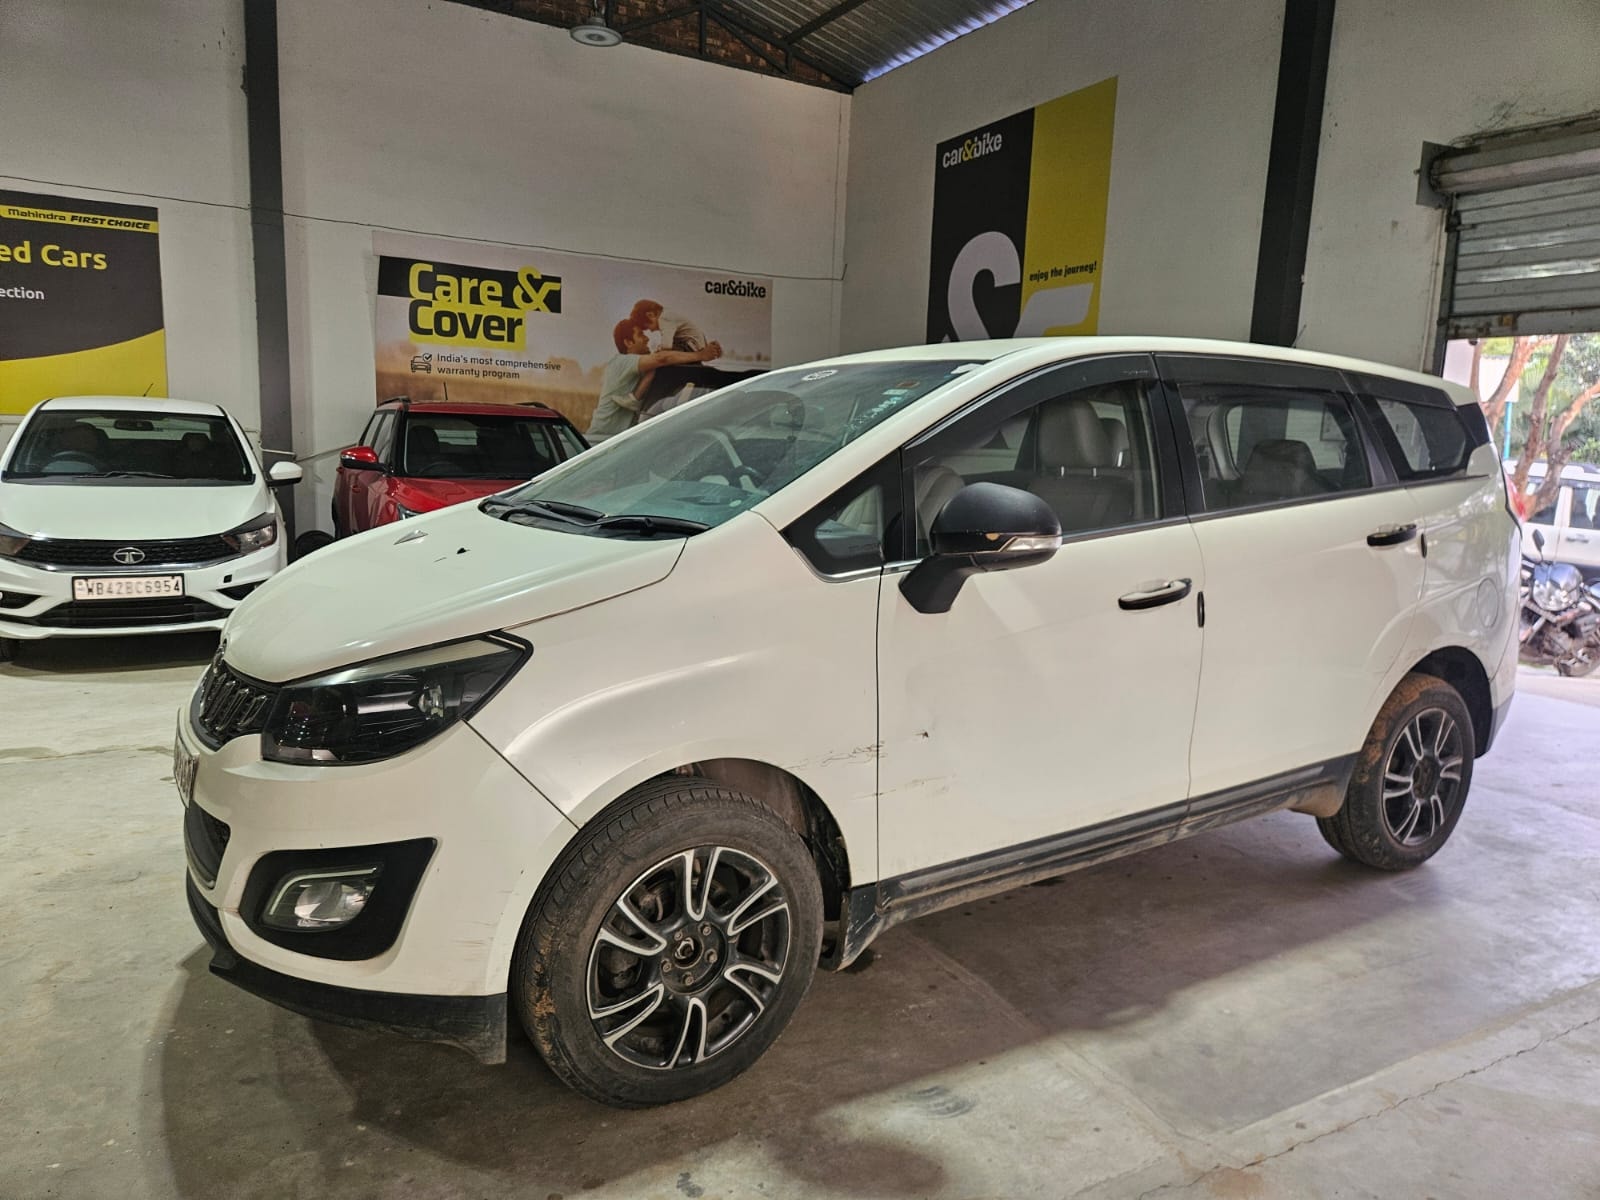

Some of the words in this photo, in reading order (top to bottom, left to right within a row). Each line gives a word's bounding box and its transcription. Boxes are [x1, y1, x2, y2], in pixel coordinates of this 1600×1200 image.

[942, 132, 1003, 168] car&bike
[70, 214, 107, 225] FIRST
[107, 219, 151, 230] CHOICE
[40, 244, 108, 271] Cars
[1050, 266, 1063, 278] the
[1063, 261, 1097, 278] journey!
[409, 262, 503, 306] Care
[512, 265, 561, 313] &
[705, 280, 766, 298] car&bike
[408, 299, 523, 343] Cover
[437, 353, 468, 363] India's
[470, 356, 493, 366] most
[495, 358, 561, 371] comprehensive
[437, 366, 480, 378] warranty
[482, 370, 520, 380] program
